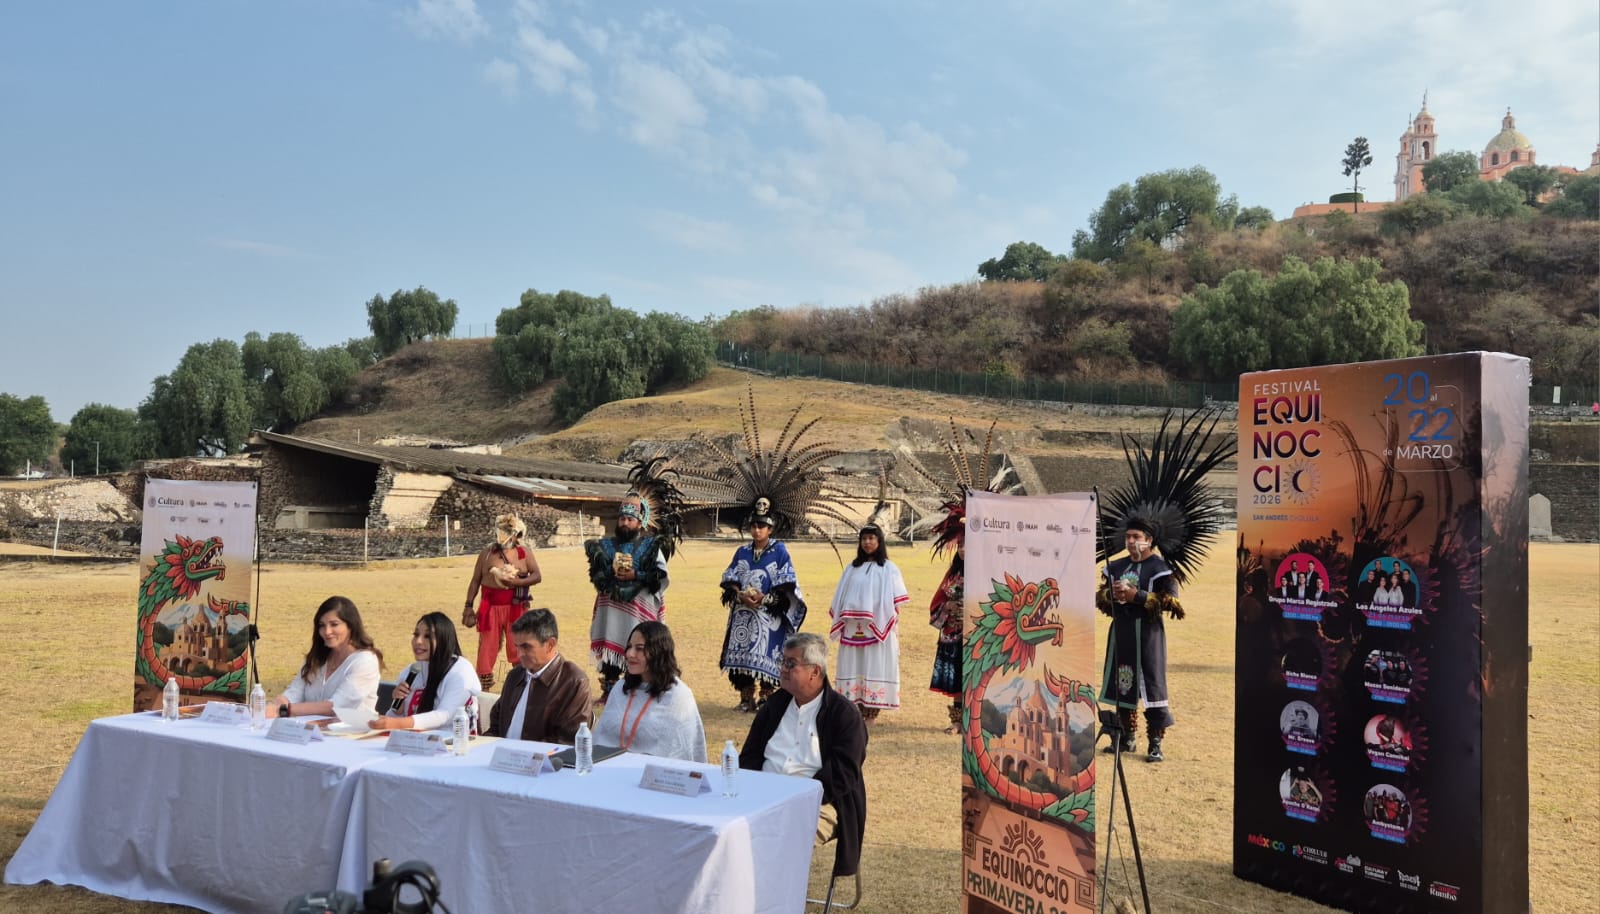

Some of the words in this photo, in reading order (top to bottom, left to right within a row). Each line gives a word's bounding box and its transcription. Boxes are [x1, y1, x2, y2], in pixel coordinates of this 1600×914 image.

[1254, 379, 1321, 396] FESTIVAL
[1382, 371, 1430, 406] 20
[1430, 393, 1438, 402] al
[1253, 394, 1322, 426] EQUI
[1407, 407, 1454, 442] 22
[1253, 428, 1321, 460] NOC
[1396, 444, 1453, 460] MARZO
[157, 496, 185, 506] Cultura
[1253, 494, 1281, 505] 2026
[983, 517, 1011, 530] Cultura
[1355, 602, 1369, 610] Los
[1369, 601, 1398, 614] Ángeles
[1398, 606, 1423, 615] Azules
[982, 847, 1069, 905] EQUINOCCIO
